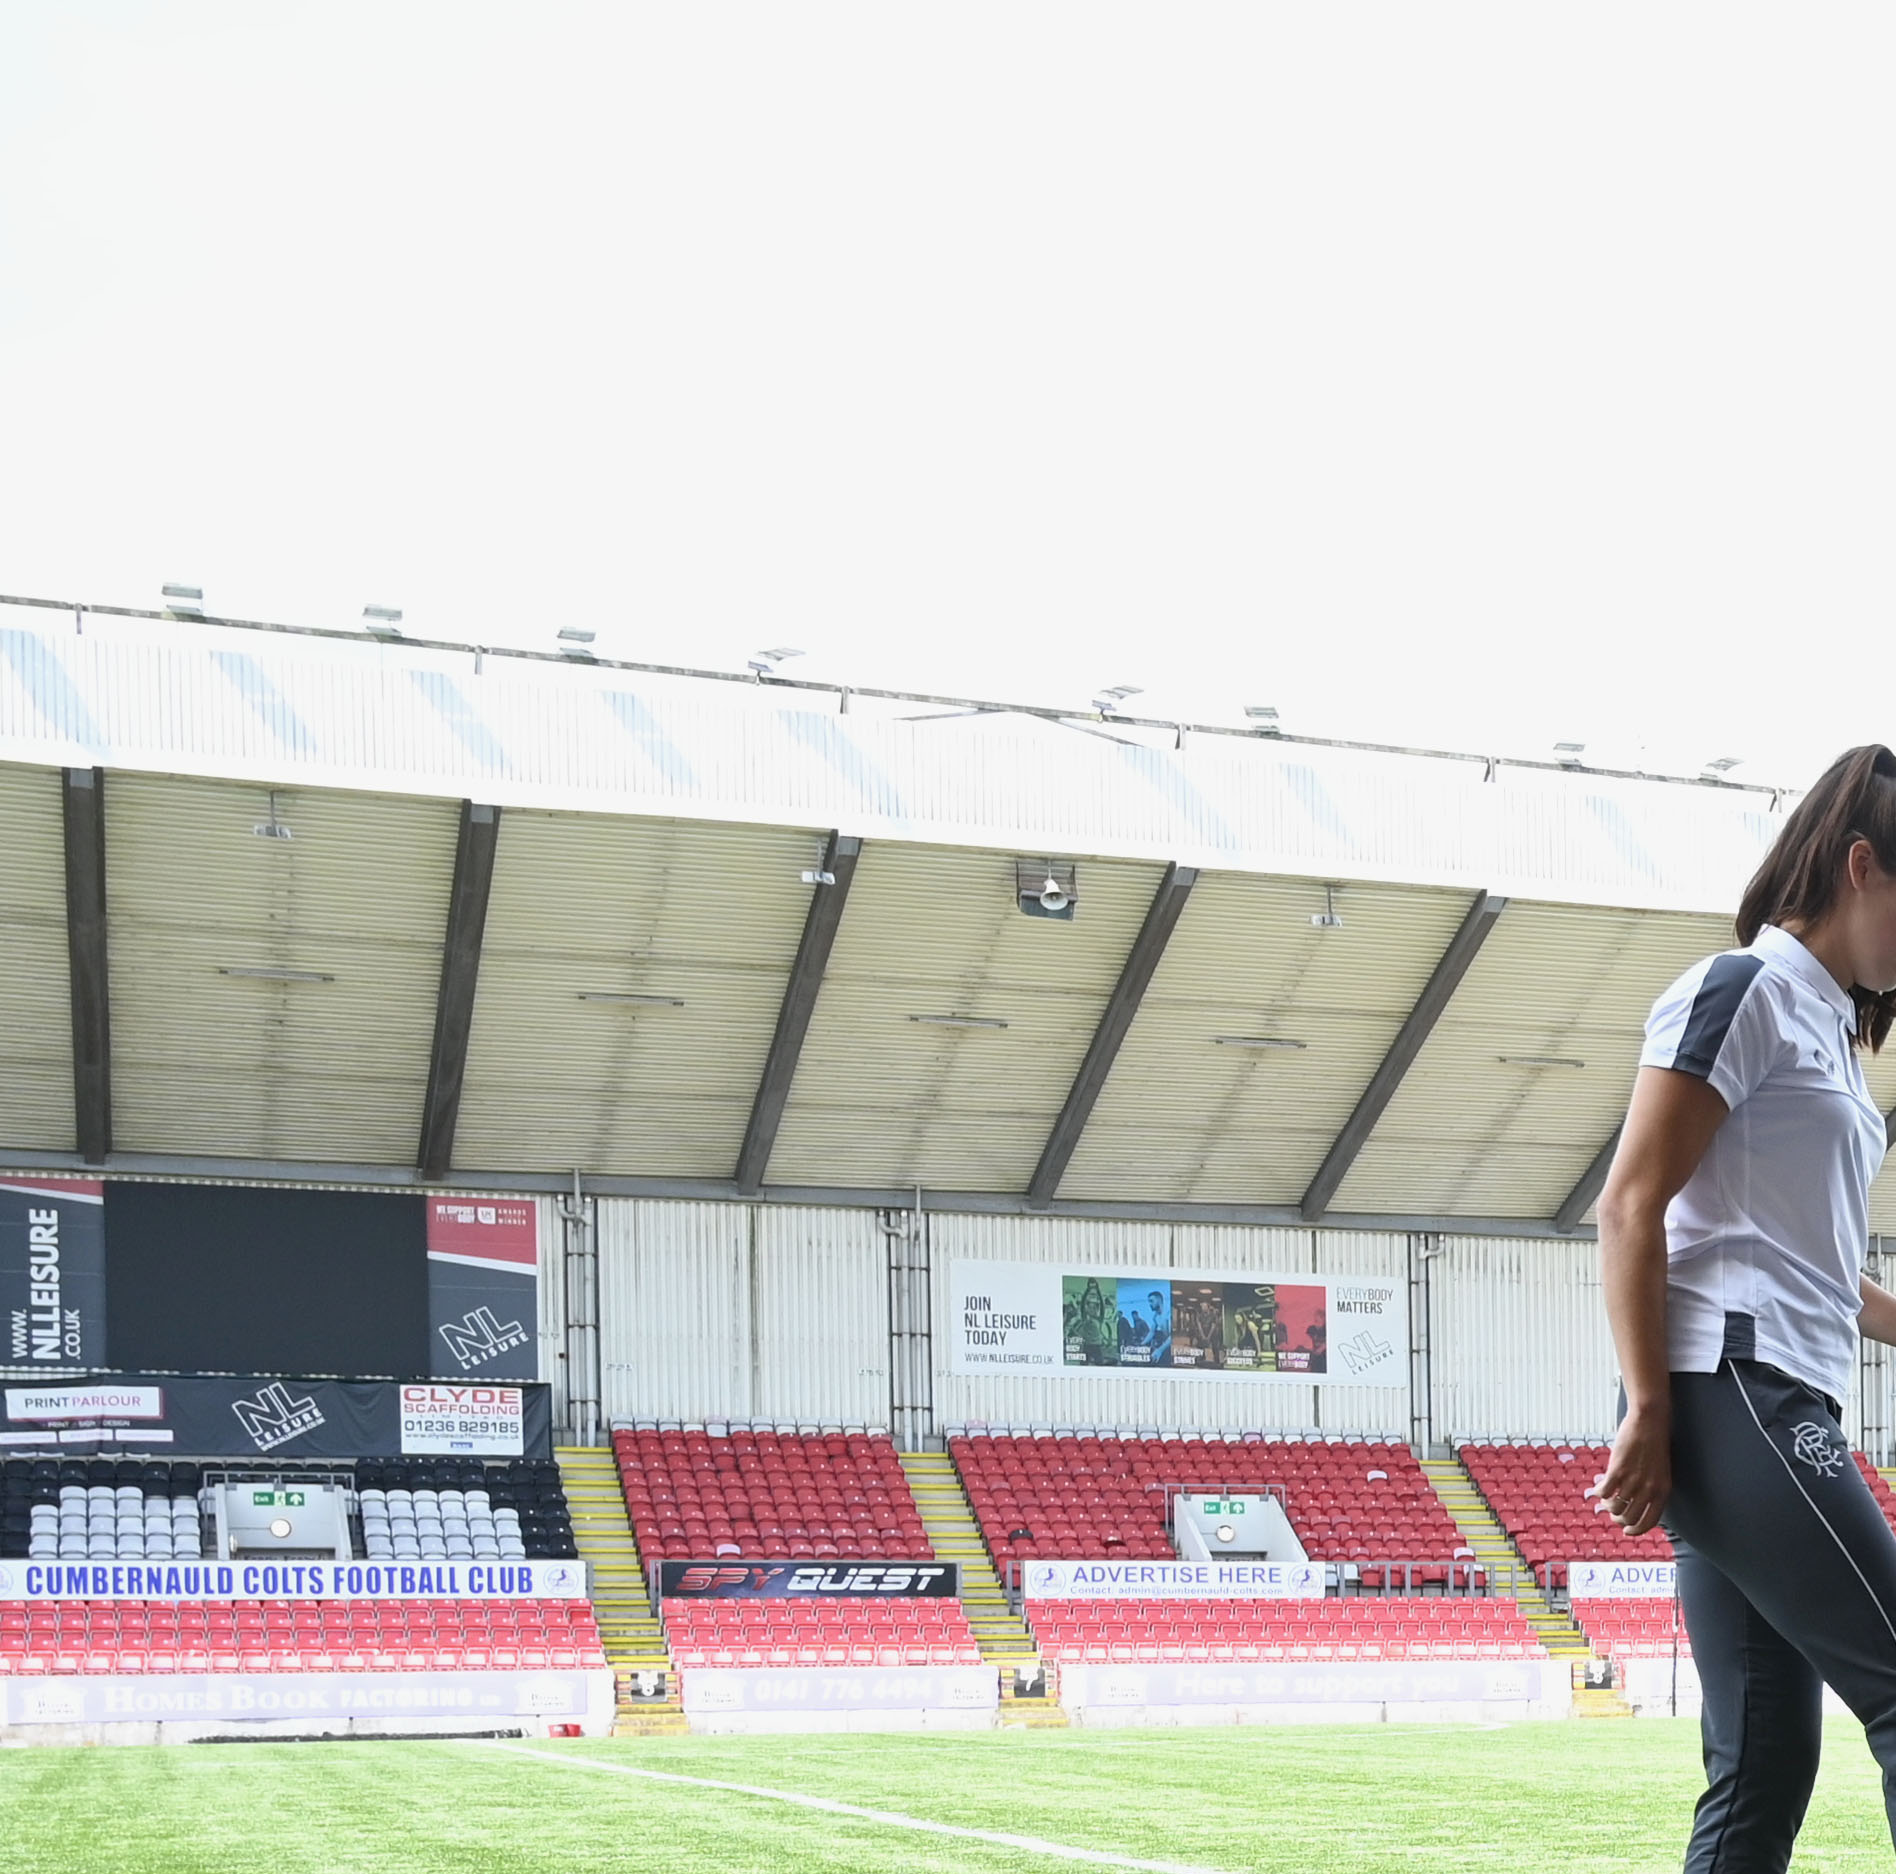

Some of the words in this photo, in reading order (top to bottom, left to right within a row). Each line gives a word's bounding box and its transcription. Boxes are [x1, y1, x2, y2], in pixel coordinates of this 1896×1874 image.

[29, 1209, 61, 1359] NLLEISURE
[1337, 1287, 1393, 1301] EVERYBODY
[964, 1296, 991, 1311] JOIN
[1337, 1301, 1383, 1314] MATTERS
[964, 1313, 981, 1328] NL
[984, 1314, 1037, 1330] LEISURE
[64, 1309, 81, 1360] .CO.UK
[439, 1305, 523, 1361] NL
[964, 1330, 1007, 1346] TODAY
[461, 1332, 529, 1371] LEISURE
[403, 1388, 519, 1404] CLYDE
[231, 1382, 316, 1438] NL
[404, 1403, 520, 1415] SCAFFOLDING
[254, 1407, 322, 1447] LEISURE
[404, 1420, 455, 1432] 01236
[459, 1421, 519, 1434] 829185
[26, 1566, 233, 1595] CUMBERNAULD
[243, 1566, 325, 1594] COLTS
[333, 1566, 459, 1594] FOOTBALL
[468, 1566, 533, 1593] CLUB
[1073, 1566, 1209, 1583] ADVERTISE
[1219, 1567, 1282, 1583] HERE
[104, 1686, 222, 1714] HOMES
[231, 1684, 336, 1711] BOOK
